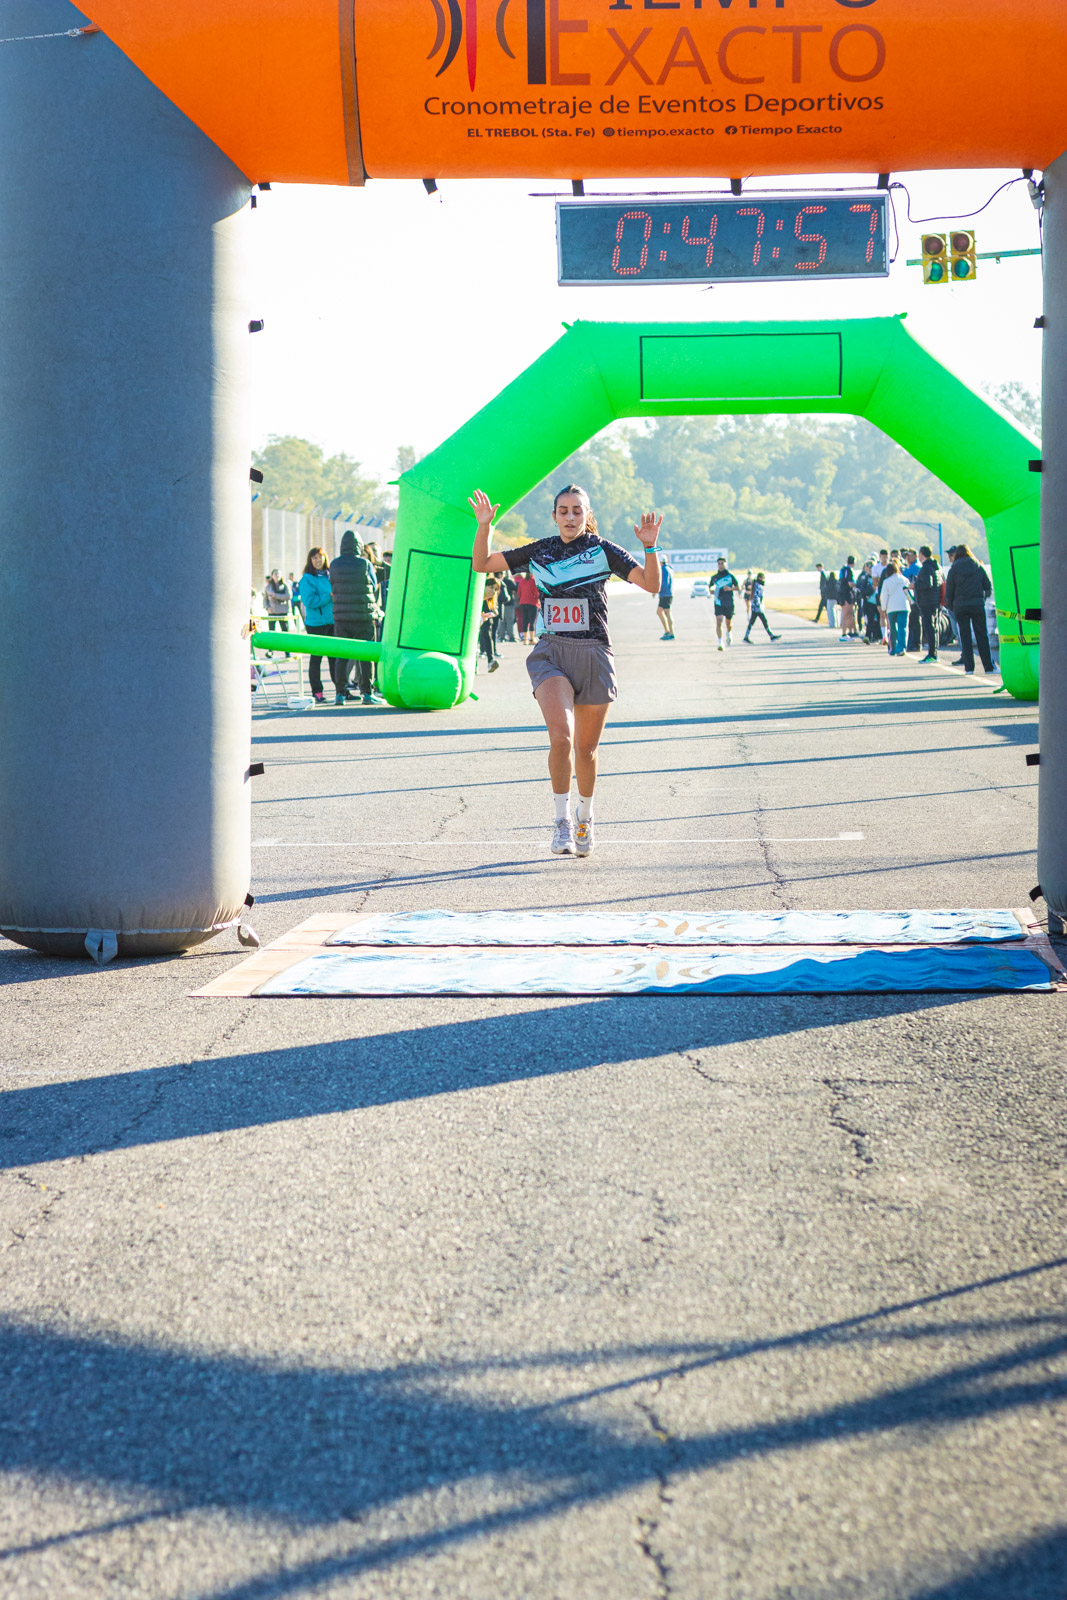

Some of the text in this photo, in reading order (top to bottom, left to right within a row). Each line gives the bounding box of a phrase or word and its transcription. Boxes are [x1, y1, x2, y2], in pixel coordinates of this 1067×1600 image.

[424, 92, 884, 118] Cronometraje de Eventos Deportivos
[467, 124, 842, 139] EL TREBOL (Sta. Fe) tiempo.exacto Tiempo Exacto
[552, 605, 581, 624] 210
